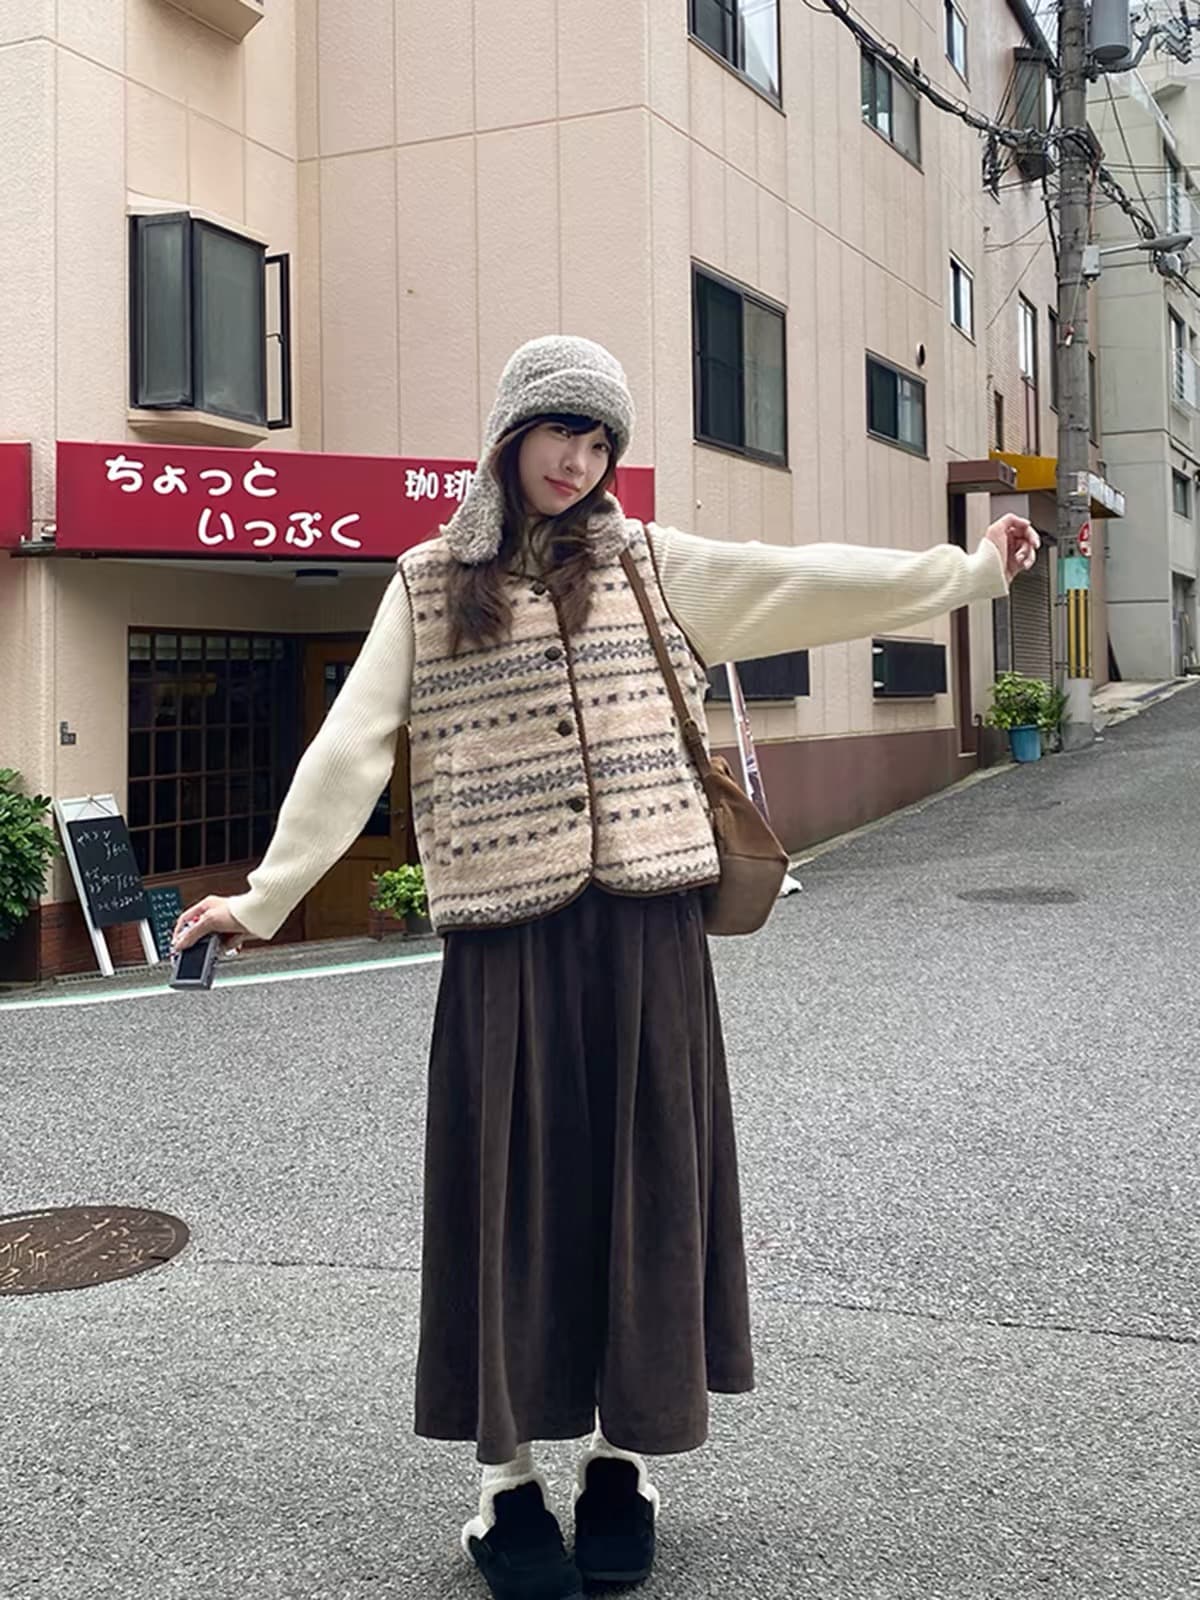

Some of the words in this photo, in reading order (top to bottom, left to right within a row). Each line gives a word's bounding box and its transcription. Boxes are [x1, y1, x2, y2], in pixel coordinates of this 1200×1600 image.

[105, 454, 278, 498] ちょっと
[197, 507, 361, 549] いっぷく
